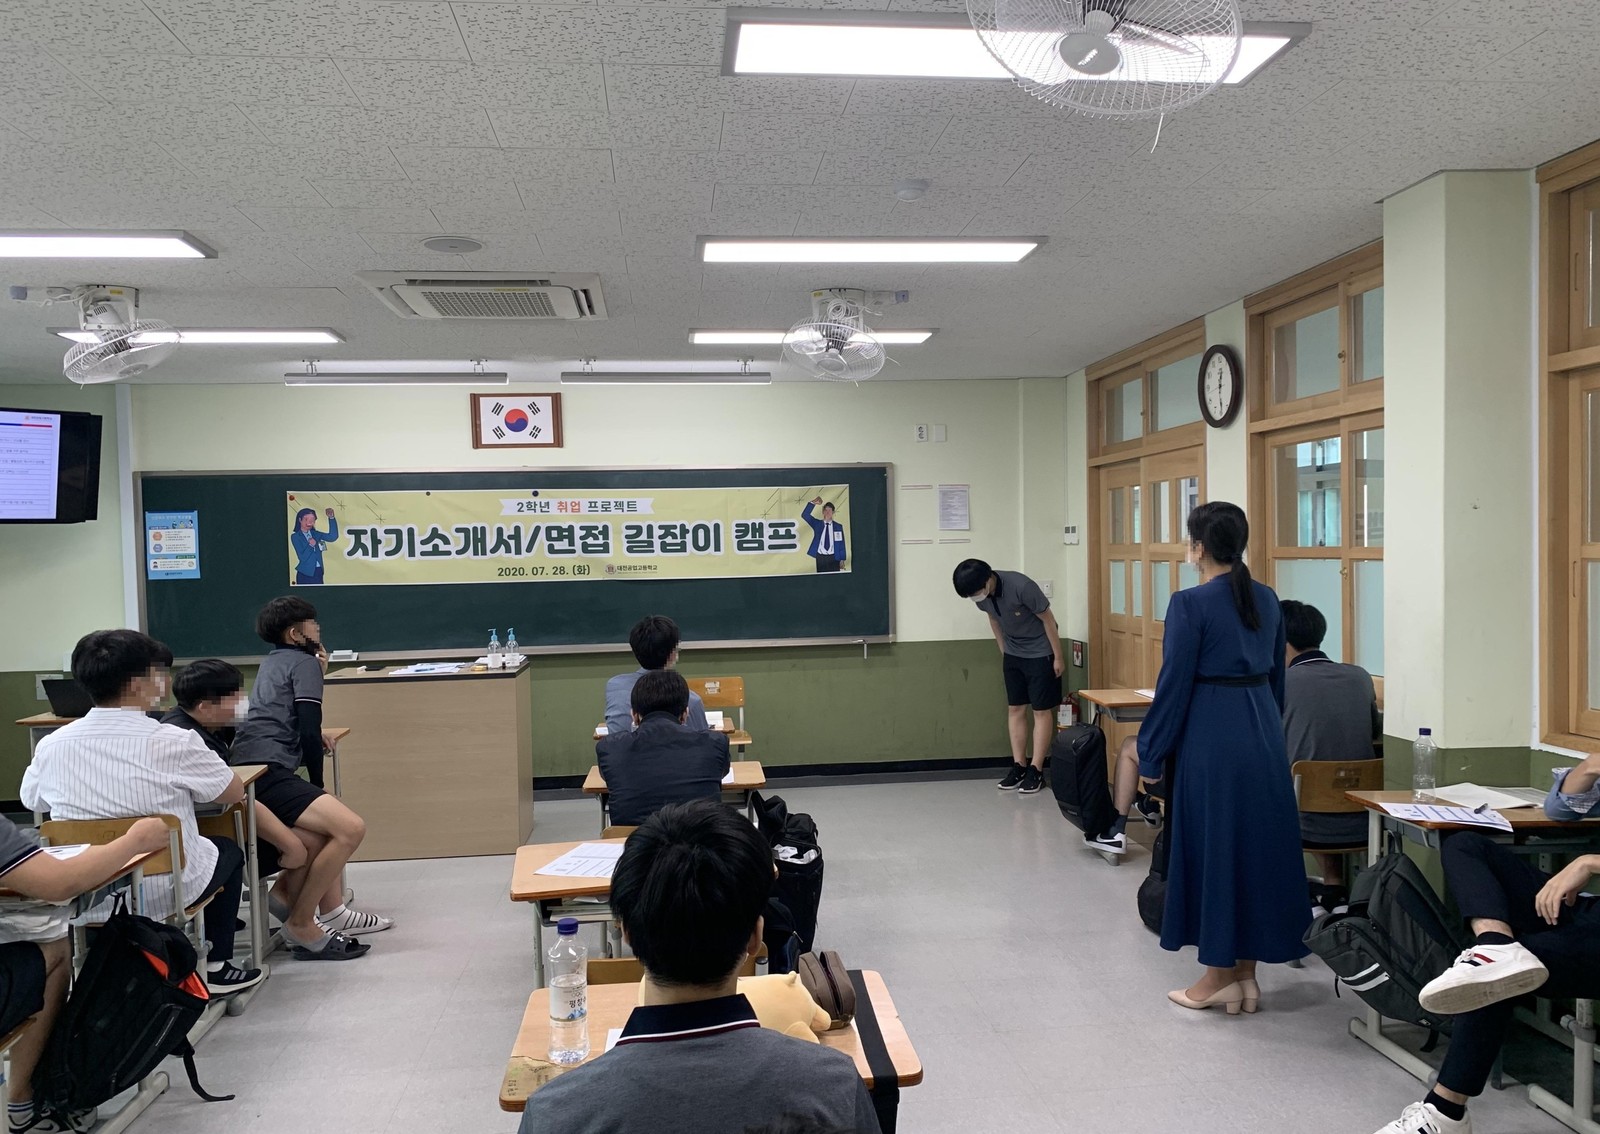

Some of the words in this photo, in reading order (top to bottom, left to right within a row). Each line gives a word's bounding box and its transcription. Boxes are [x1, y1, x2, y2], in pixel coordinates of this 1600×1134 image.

[516, 501, 550, 513] 2학년
[557, 501, 581, 513] 취업
[588, 500, 638, 513] 프로젝트
[346, 525, 610, 557] 자기소개서/면접
[624, 522, 722, 554] 길잡이
[734, 521, 798, 552] 캠프
[497, 567, 529, 577] 2020.
[531, 566, 549, 576] 07.
[552, 565, 569, 576] 28.
[572, 564, 591, 576] (화)
